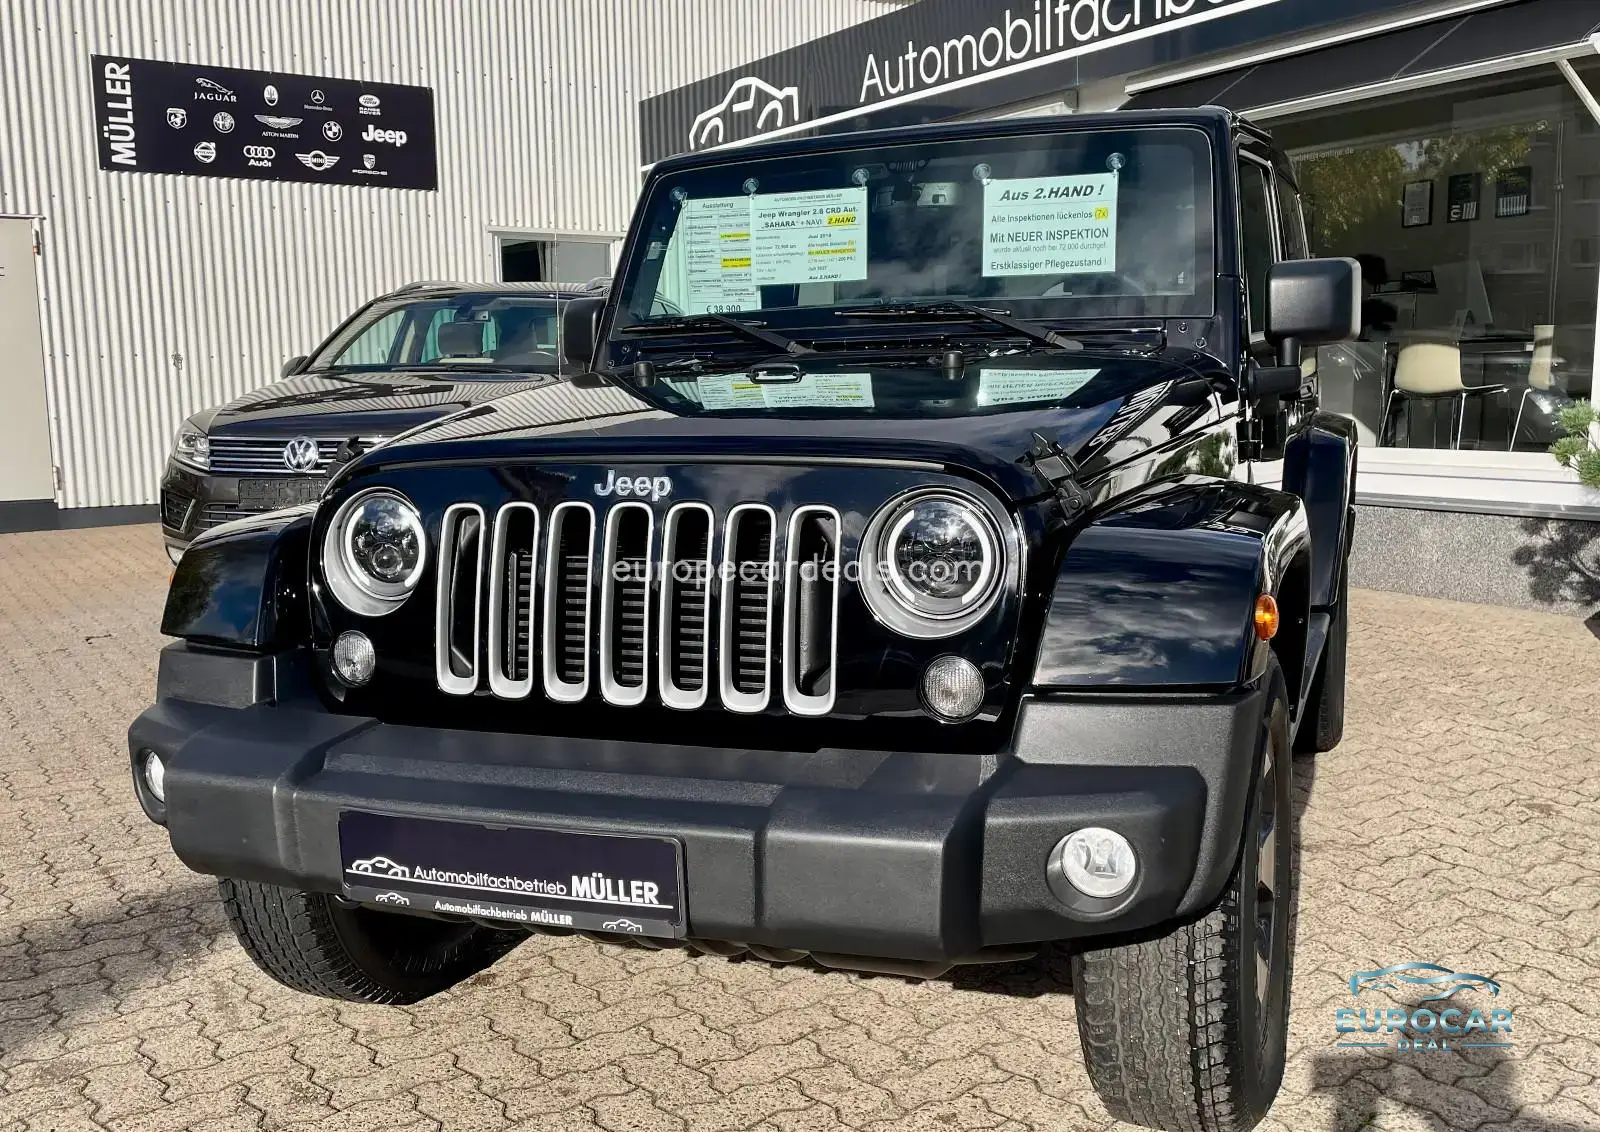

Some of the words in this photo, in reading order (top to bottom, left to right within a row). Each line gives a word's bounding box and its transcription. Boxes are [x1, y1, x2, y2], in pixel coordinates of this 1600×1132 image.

[194, 92, 237, 103] JAGUAR
[103, 62, 137, 166] MÜLLER
[362, 124, 408, 147] Jeep
[248, 159, 272, 167] Audi
[1000, 189, 1029, 201] Aus
[1033, 185, 1094, 200] 2.HAND
[1097, 184, 1105, 196] !
[778, 210, 810, 218] Wrangler
[827, 216, 857, 225] 2.HAND
[991, 215, 1005, 223] Alle
[1007, 212, 1055, 224] Inspektionen
[1057, 210, 1093, 220] lückenlos
[990, 232, 1005, 243] Mit
[1007, 231, 1043, 242] NEUER
[1045, 227, 1109, 242] INSPEKTION
[991, 259, 1042, 271] Erstklassiger
[1045, 257, 1102, 268] Pflegezustand
[594, 470, 671, 502] Jeep
[413, 866, 567, 895] Automobilfachbetrieb
[571, 873, 660, 904] MÜLLER
[434, 900, 528, 921] Automobilfachbetrieb
[530, 911, 573, 926] MÜLLER
